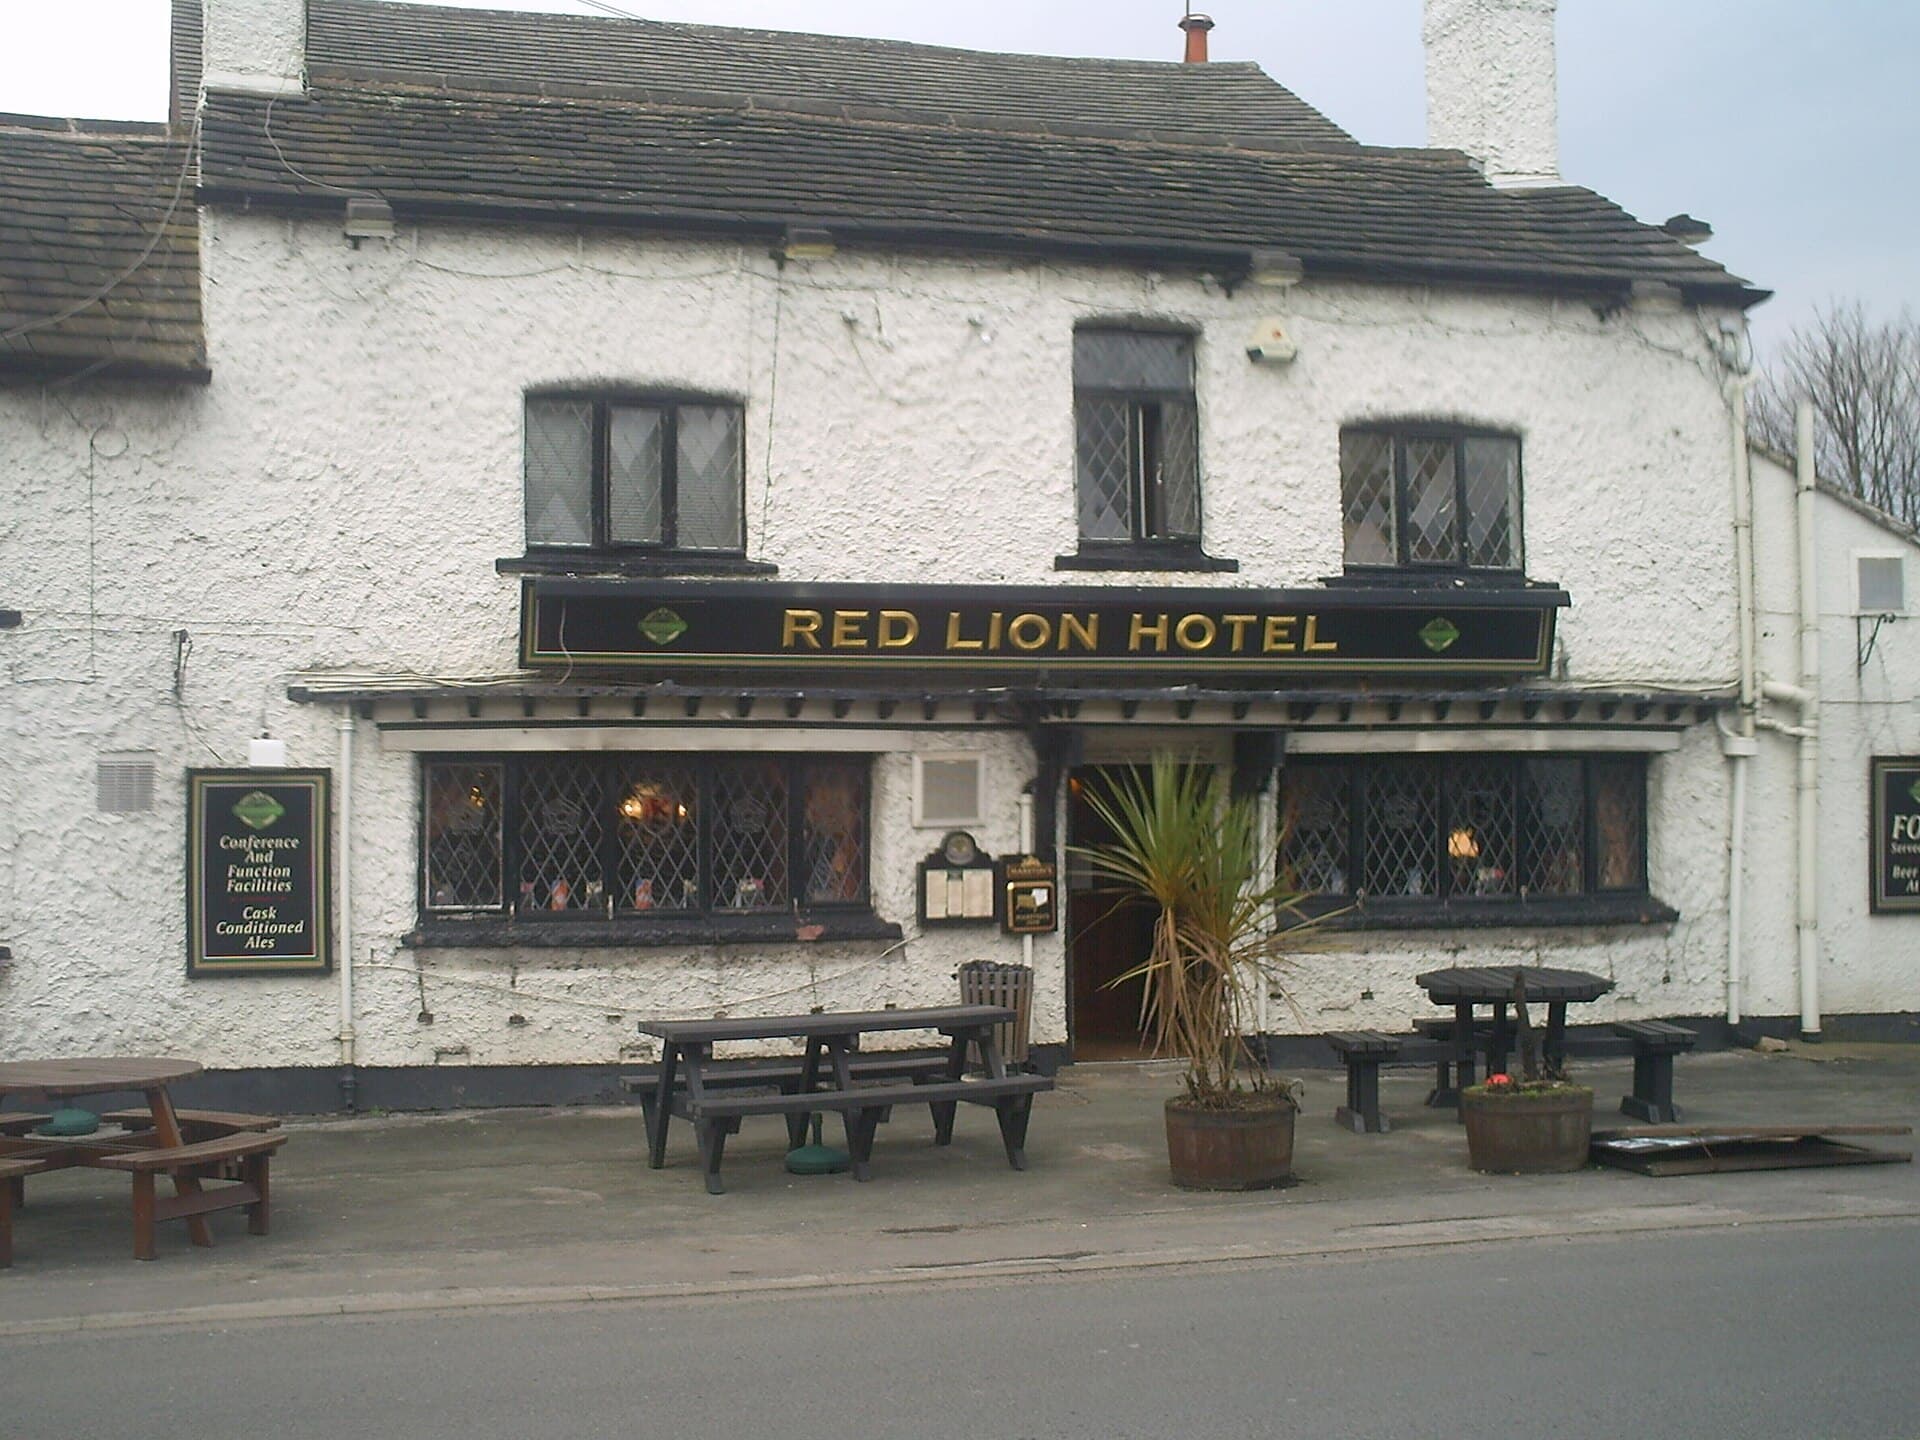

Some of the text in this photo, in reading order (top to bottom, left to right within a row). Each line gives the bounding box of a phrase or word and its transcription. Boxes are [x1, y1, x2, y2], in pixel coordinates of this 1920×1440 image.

[781, 607, 1339, 654] RED LION HOTEL
[219, 835, 300, 851] Conference
[244, 850, 274, 863] And
[227, 865, 291, 878] Function
[226, 879, 293, 893] Facilities
[242, 906, 277, 920] Cask
[216, 920, 304, 935] Conditioned
[244, 935, 275, 949] Ales
